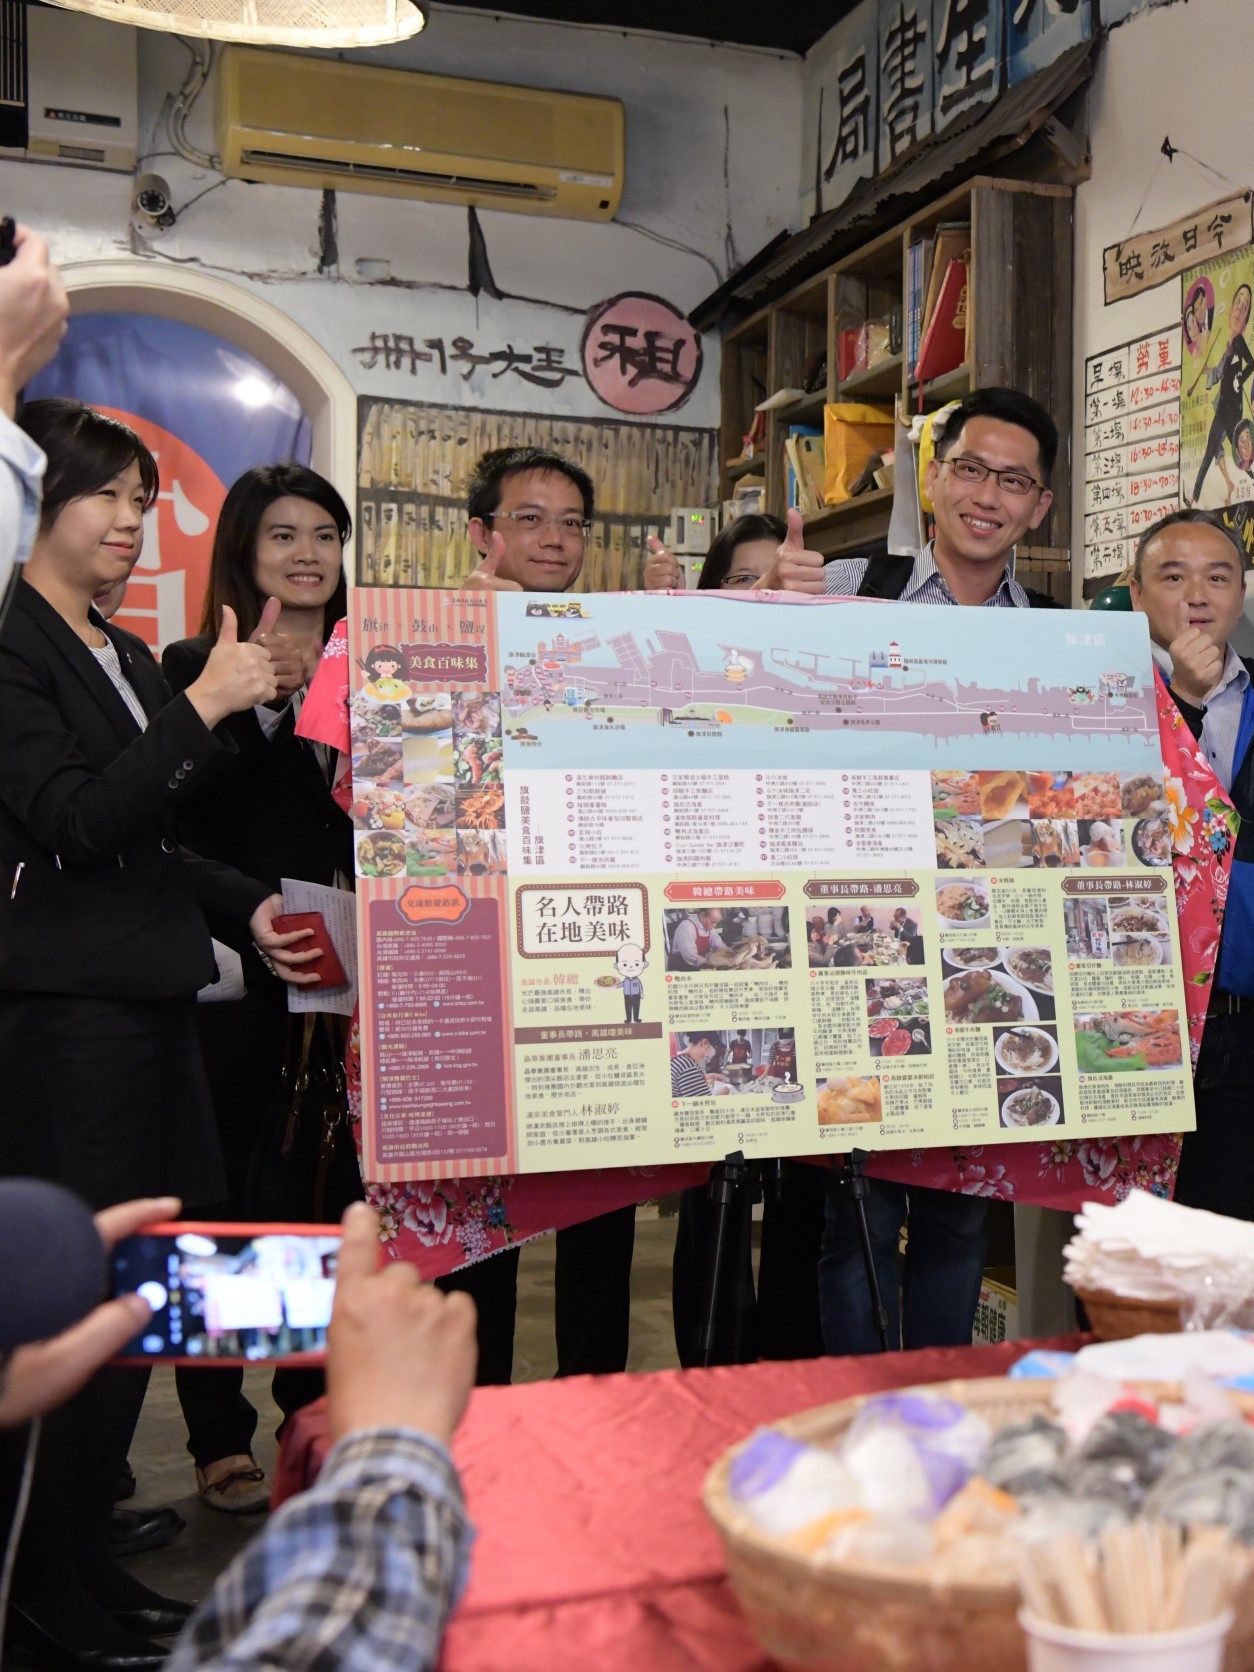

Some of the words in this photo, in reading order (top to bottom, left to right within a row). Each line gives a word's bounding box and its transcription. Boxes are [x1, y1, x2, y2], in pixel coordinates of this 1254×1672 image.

[409, 656, 478, 669] 美食百味集
[520, 785, 533, 865] 旗鼓鹽美食百味集
[535, 895, 629, 918] 名人帶路
[535, 921, 631, 943] 在地美味
